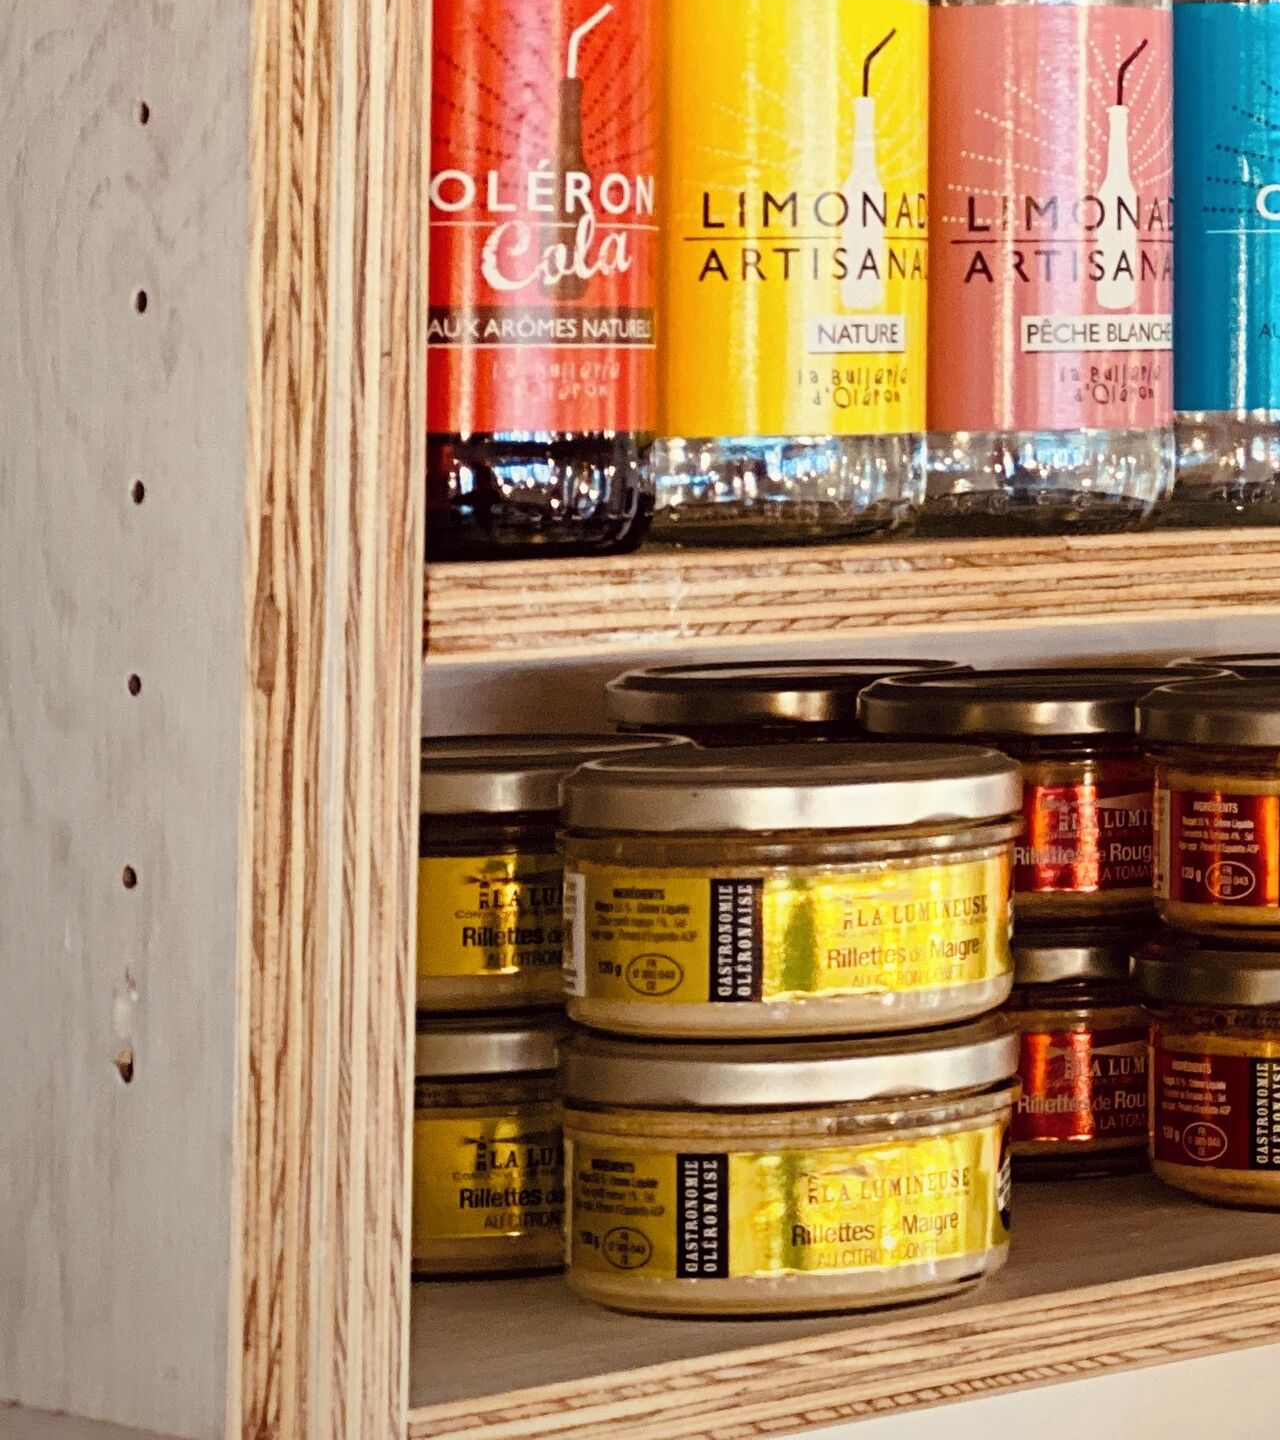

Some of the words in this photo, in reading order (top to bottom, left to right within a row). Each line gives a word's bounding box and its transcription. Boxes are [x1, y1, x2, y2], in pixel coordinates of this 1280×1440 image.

[430, 159, 656, 216] OLÉRON
[481, 212, 634, 291] Cola
[428, 318, 480, 339] AUX
[484, 314, 578, 339] ARÔMES
[817, 322, 899, 345] NATURE
[1026, 319, 1100, 344] PÊCHE
[1103, 810, 1153, 829] LUMI
[857, 905, 883, 927] LA
[893, 893, 988, 923] LUMINEUSE
[717, 884, 733, 997] GASTRONOMIE
[737, 883, 753, 997] OLÉRONAISE
[826, 945, 907, 969] Rillettes
[1256, 1062, 1270, 1165] GASTRONOMIE
[489, 1150, 519, 1170] LA
[459, 1187, 543, 1209] Rillettes
[860, 1165, 971, 1201] LUMINEUSE
[684, 1160, 699, 1273] GASTRONOMIE
[703, 1159, 718, 1273] OLÉRONAISE
[791, 1220, 876, 1247] Rillettes
[901, 1211, 960, 1237] Maigre
